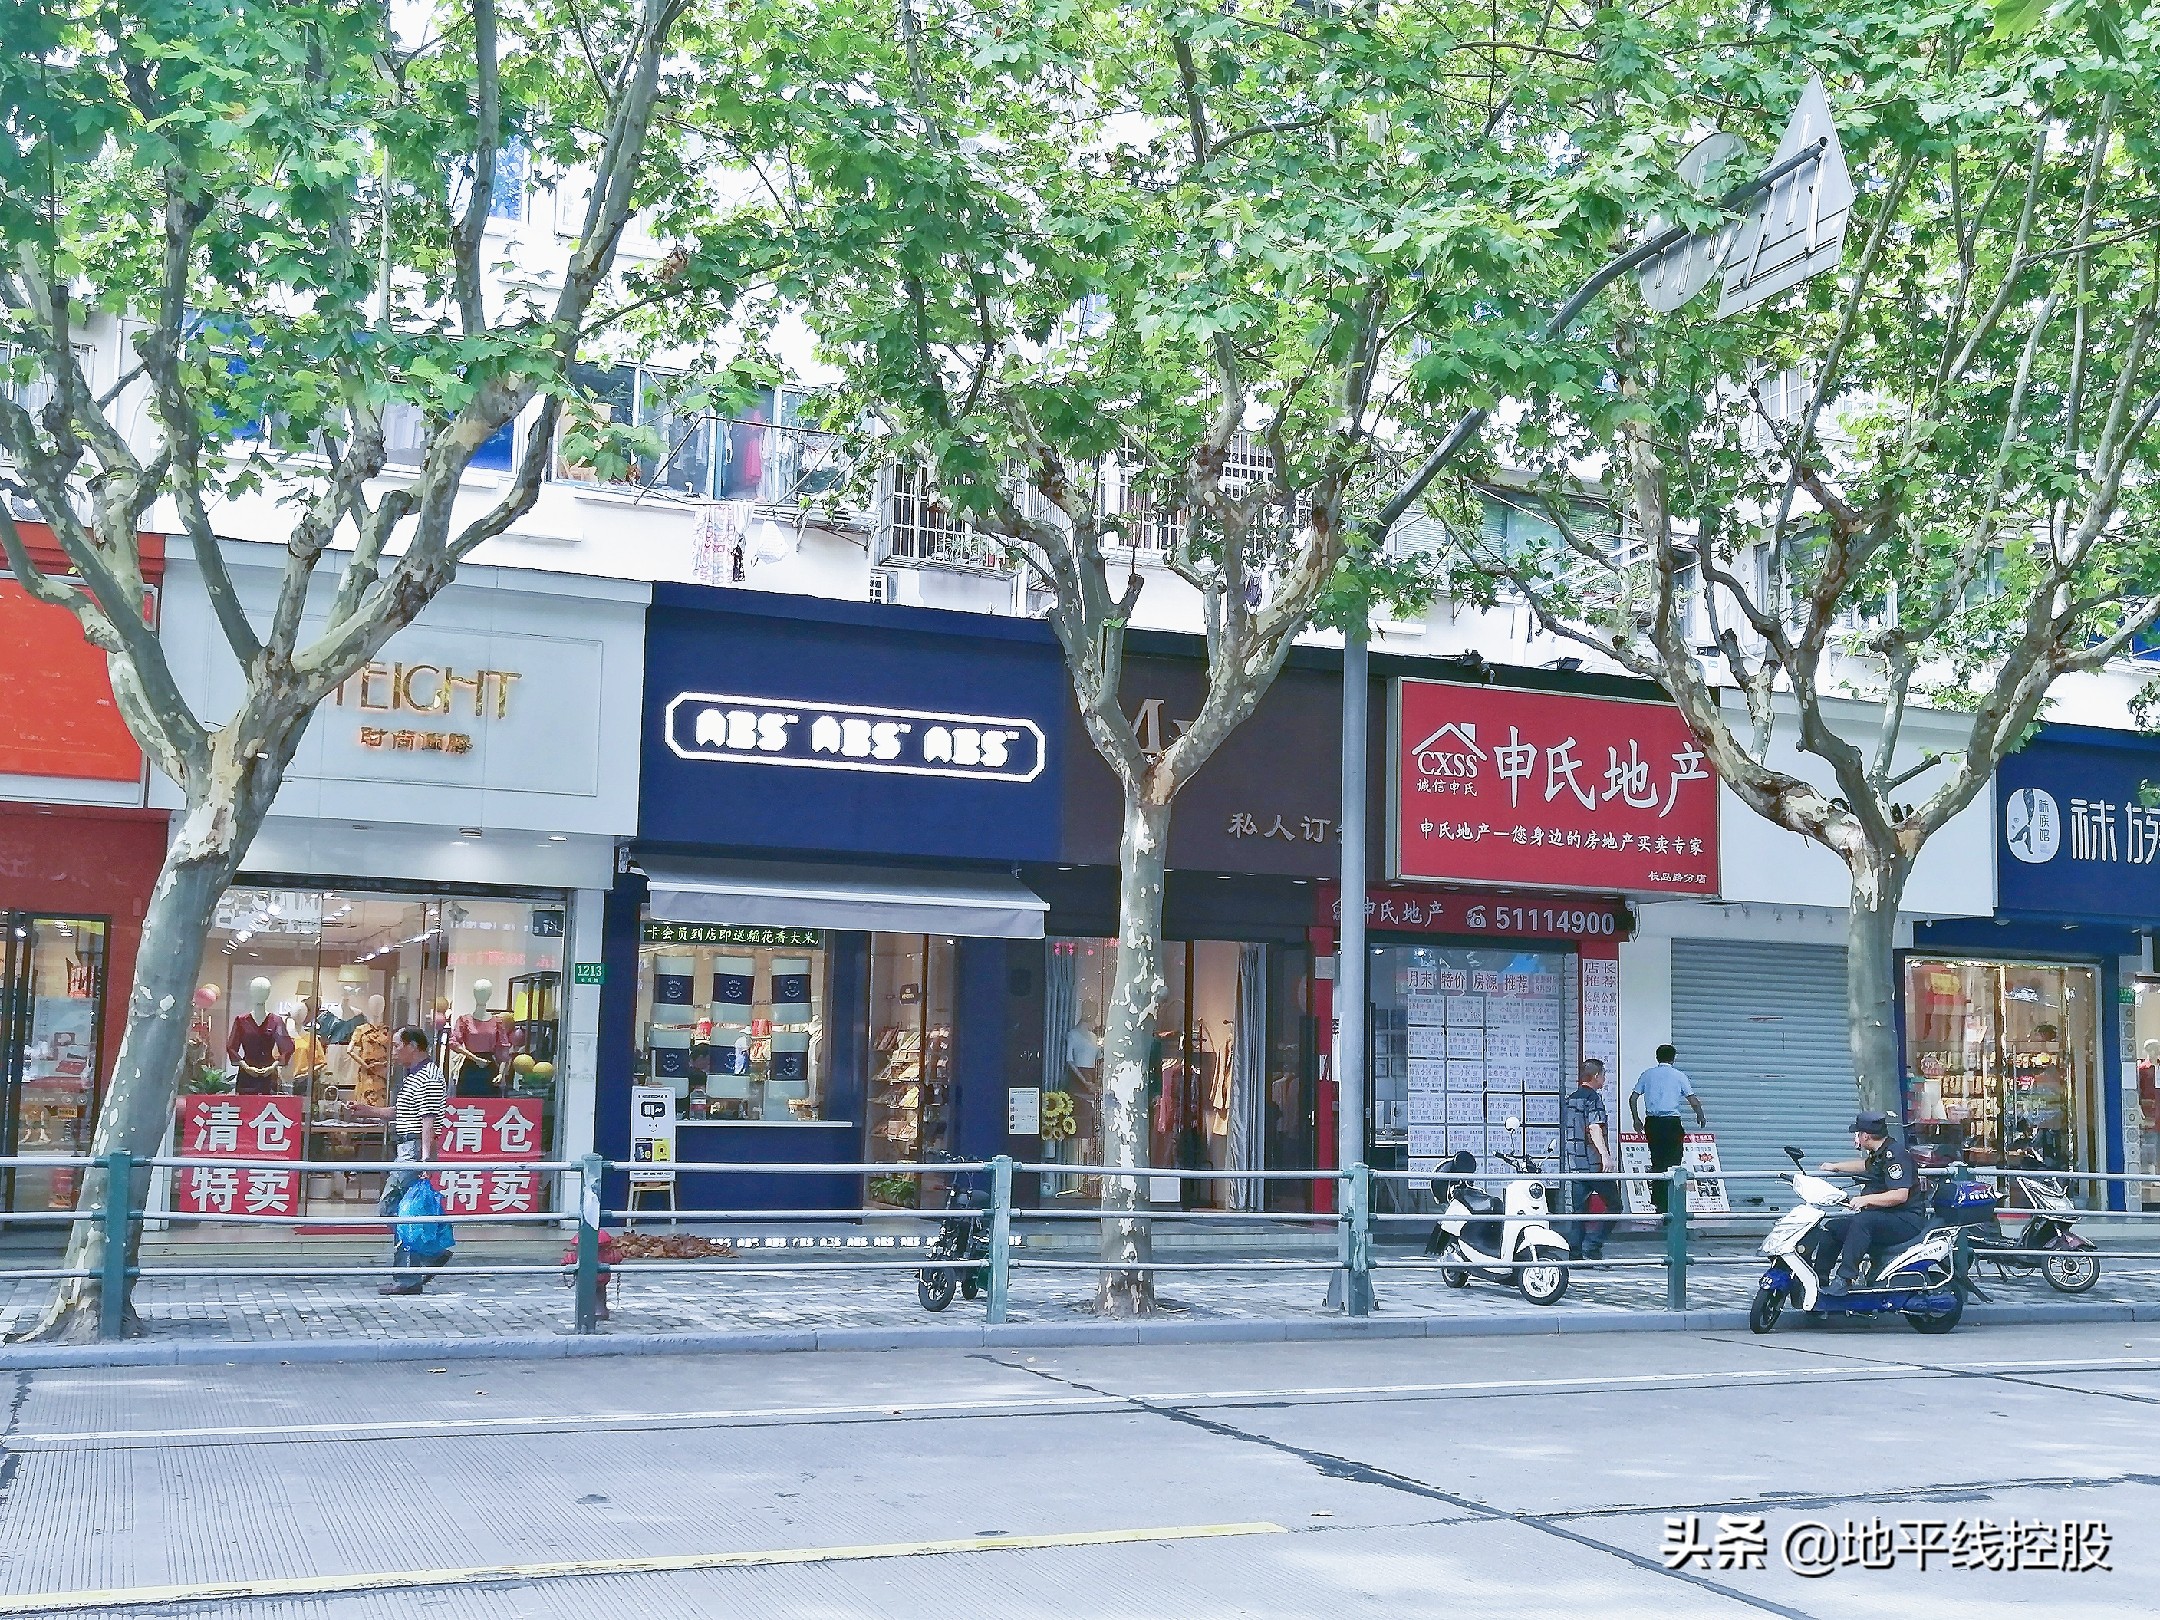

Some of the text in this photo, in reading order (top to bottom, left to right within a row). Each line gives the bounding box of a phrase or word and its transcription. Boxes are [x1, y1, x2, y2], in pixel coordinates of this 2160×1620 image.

[1417, 751, 1479, 779] CXSS
[1493, 726, 1710, 818] 申氏地产
[1416, 778, 1479, 797] 诚信申氏
[1227, 812, 1343, 844] 私人订
[1496, 906, 1617, 935] 51114900
[577, 965, 603, 977] 1213
[1408, 970, 1434, 988] 月末
[1441, 972, 1466, 990] 特价
[1473, 973, 1499, 991] 房源
[1504, 975, 1529, 993] 推荐
[1584, 962, 1616, 974] 店长
[1584, 975, 1616, 988] 推荐
[192, 1101, 294, 1152] 清仓
[441, 1104, 535, 1153] 清仓
[190, 1167, 291, 1213] 特卖
[438, 1170, 532, 1213] 特卖
